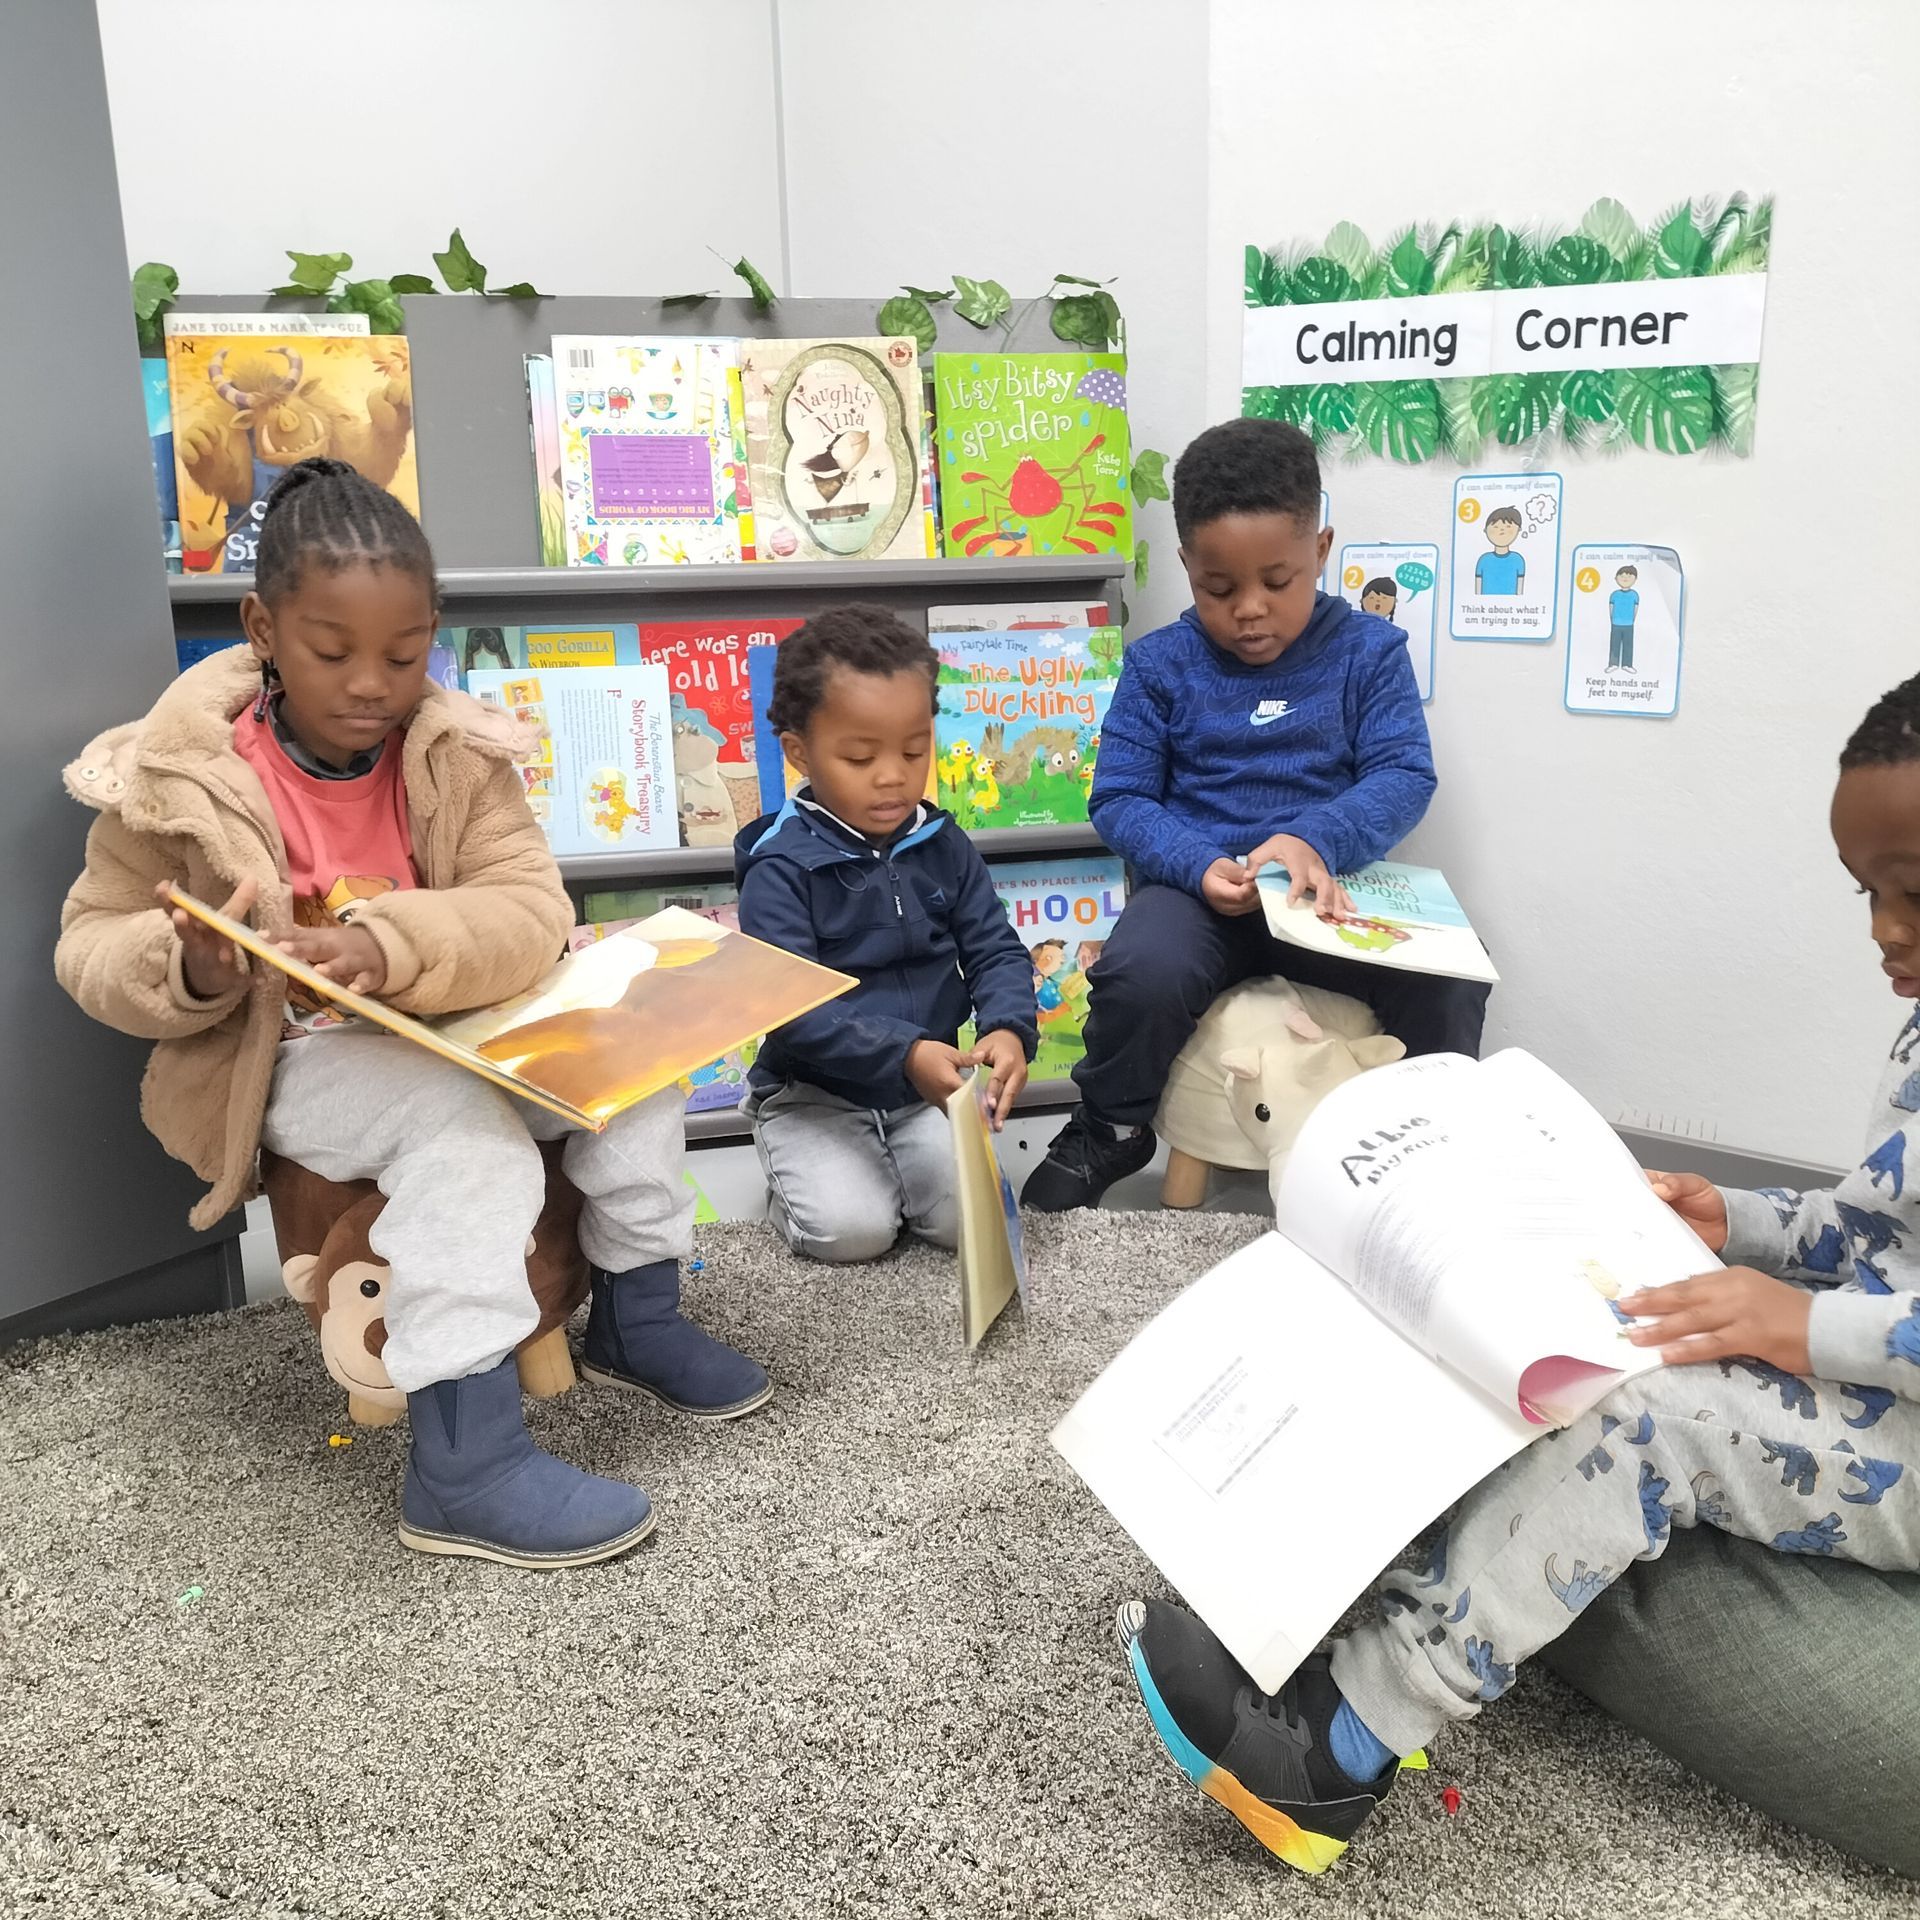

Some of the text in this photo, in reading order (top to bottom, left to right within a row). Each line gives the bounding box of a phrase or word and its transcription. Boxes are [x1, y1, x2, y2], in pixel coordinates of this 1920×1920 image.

[172, 322, 207, 333] JANE
[211, 322, 254, 333] YOLEN
[313, 322, 364, 333] TGUE
[1295, 308, 1689, 367] Calming Corner
[943, 360, 1075, 410] Itsy Bitsy
[790, 383, 876, 419] Naughty
[814, 411, 865, 439] Nina
[961, 400, 1073, 462] spider
[598, 505, 635, 514] WORDS
[649, 505, 678, 514] BOOK
[1463, 502, 1475, 521] 3
[1347, 569, 1359, 587] 2
[1580, 571, 1594, 590] 4
[1461, 605, 1486, 614] Think
[1487, 605, 1513, 614] about
[1516, 605, 1539, 614] what
[1481, 616, 1508, 627] trying
[695, 634, 739, 654] was
[1005, 639, 1029, 653] Time
[675, 660, 719, 691] old
[968, 655, 1085, 688] The Ugly
[1585, 677, 1660, 688] Keep hands and
[1587, 687, 1606, 698] feet
[1608, 689, 1618, 697] to
[1256, 699, 1288, 716] NIKE
[629, 699, 652, 835] Storybook Treasury
[1021, 879, 1037, 888] NO
[1041, 876, 1078, 886] PLACE
[1081, 875, 1106, 884] LIKE
